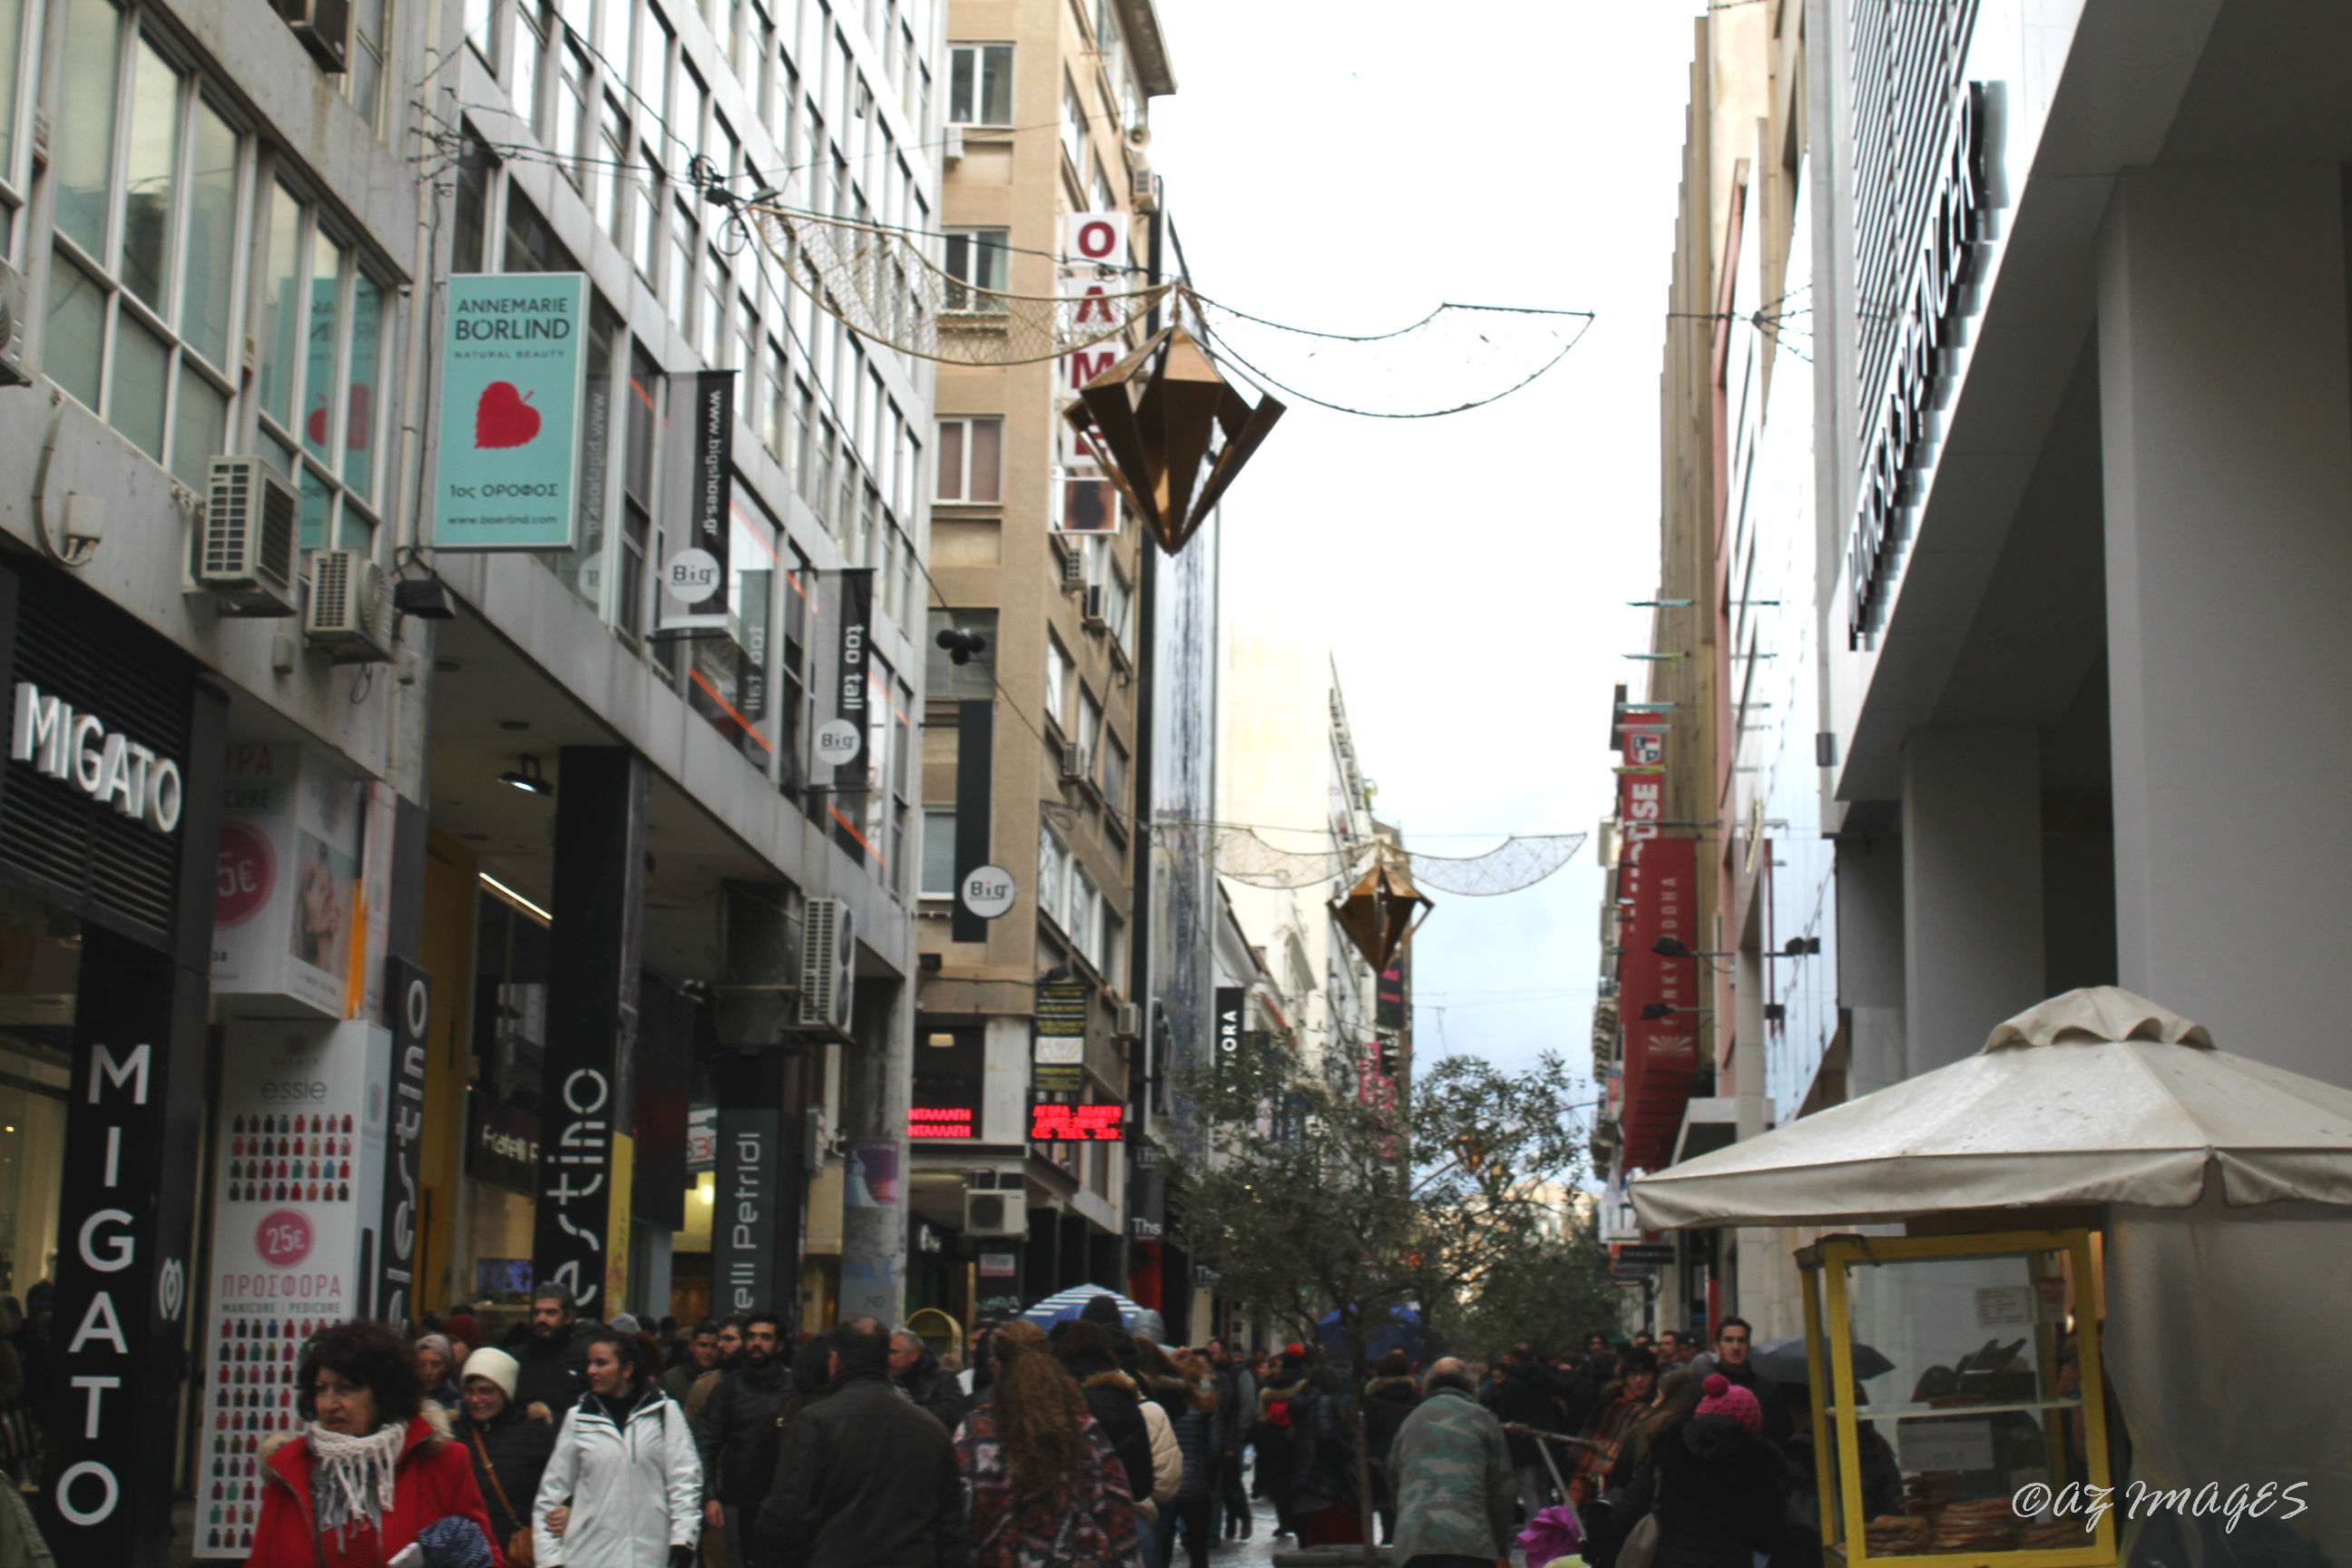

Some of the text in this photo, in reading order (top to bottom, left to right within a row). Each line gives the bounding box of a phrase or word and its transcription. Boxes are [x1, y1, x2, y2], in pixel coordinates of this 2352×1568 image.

[456, 298, 569, 313] ANNEMARIE
[455, 349, 565, 359] NATURAL BEAUTY
[703, 389, 722, 536] www.bigshoes.gr
[447, 514, 558, 526] www.boerlind.com
[671, 564, 712, 585] Big
[843, 624, 865, 710] too tall
[820, 732, 855, 749] Big
[11, 682, 181, 833] MIGATO
[969, 880, 1009, 899] Big
[260, 1081, 328, 1101] essie
[731, 1132, 761, 1250] Petridi
[55, 1043, 152, 1526] MIGATO
[220, 1273, 342, 1298] ΠΡΟΣΦΟΡΑ
[220, 1301, 341, 1314] MANICURE PEDICURE
